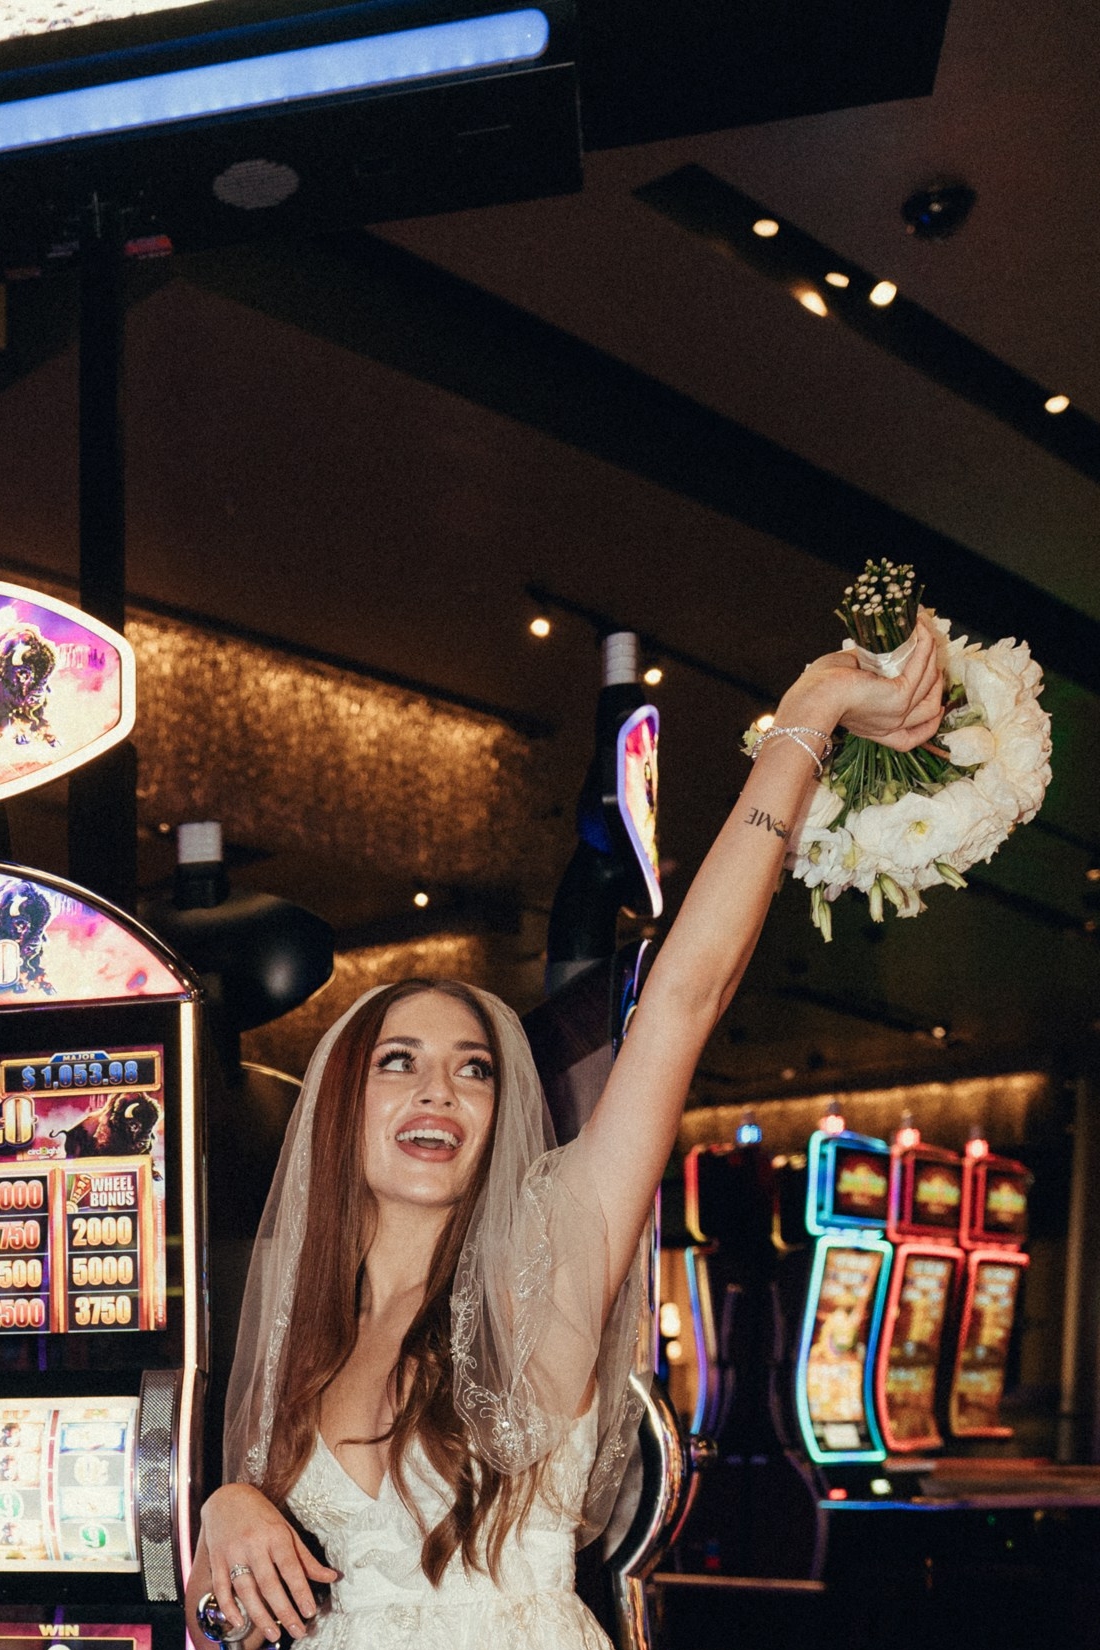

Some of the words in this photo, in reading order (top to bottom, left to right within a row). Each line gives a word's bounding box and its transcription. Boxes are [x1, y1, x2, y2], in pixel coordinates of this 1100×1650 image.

[62, 1053, 96, 1062] MAJOR
[90, 1174, 134, 1192] WHEEL
[89, 1191, 135, 1208] BONUS
[71, 1216, 133, 1247] 2000
[72, 1255, 133, 1286] 5000
[74, 1295, 132, 1326] 3750
[79, 1522, 109, 1550] 9
[38, 1624, 80, 1637] WIN
